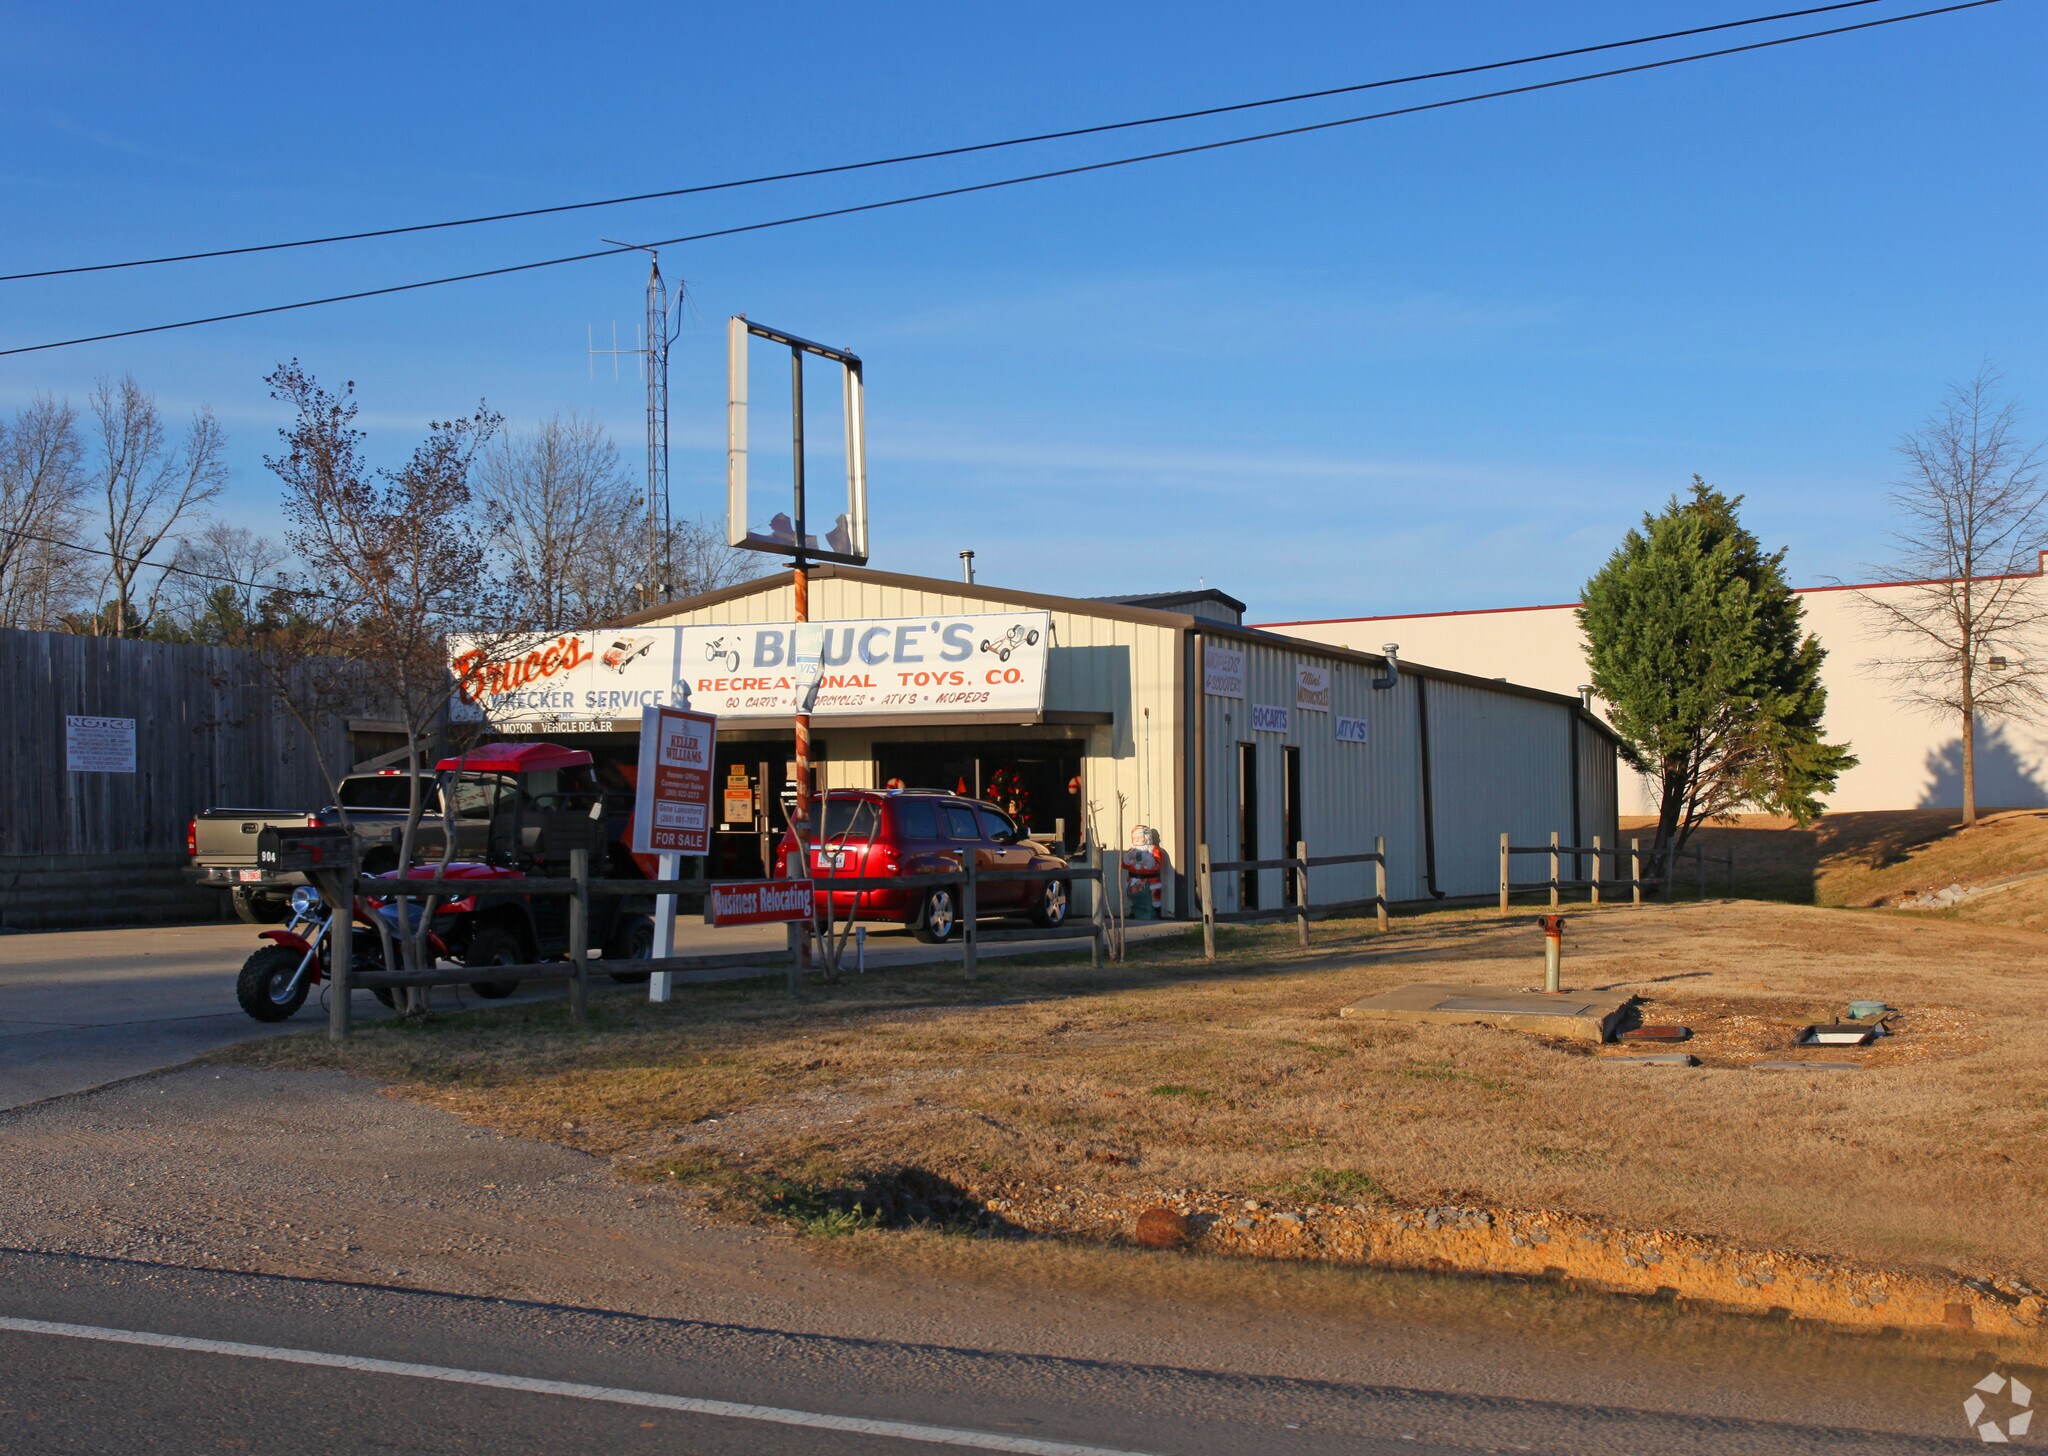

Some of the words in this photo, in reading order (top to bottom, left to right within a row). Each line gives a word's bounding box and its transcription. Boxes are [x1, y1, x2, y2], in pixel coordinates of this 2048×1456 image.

[753, 622, 975, 668] BUCE'S
[454, 637, 593, 705] Bruce's
[1301, 671, 1321, 687] Mini
[697, 674, 877, 692] RECREAONAL
[985, 669, 1024, 685] CO.
[585, 690, 664, 708] SERVICE
[725, 697, 740, 709] GO
[745, 695, 777, 708] CARTS
[881, 693, 916, 706] ATV'S
[936, 691, 990, 704] MOPEDS
[68, 718, 134, 729] NOTICE
[503, 723, 533, 734] MOTOR
[541, 722, 578, 733] VEHICLE
[579, 721, 613, 733] DEALER
[1336, 720, 1366, 739] ATV'S
[670, 735, 699, 750] KELLER
[666, 747, 703, 763] WILLIAMS
[656, 832, 675, 846] FOR
[678, 834, 703, 847] SALE
[261, 851, 276, 863] 904
[715, 888, 757, 916] Business
[760, 884, 811, 916] Relocating
